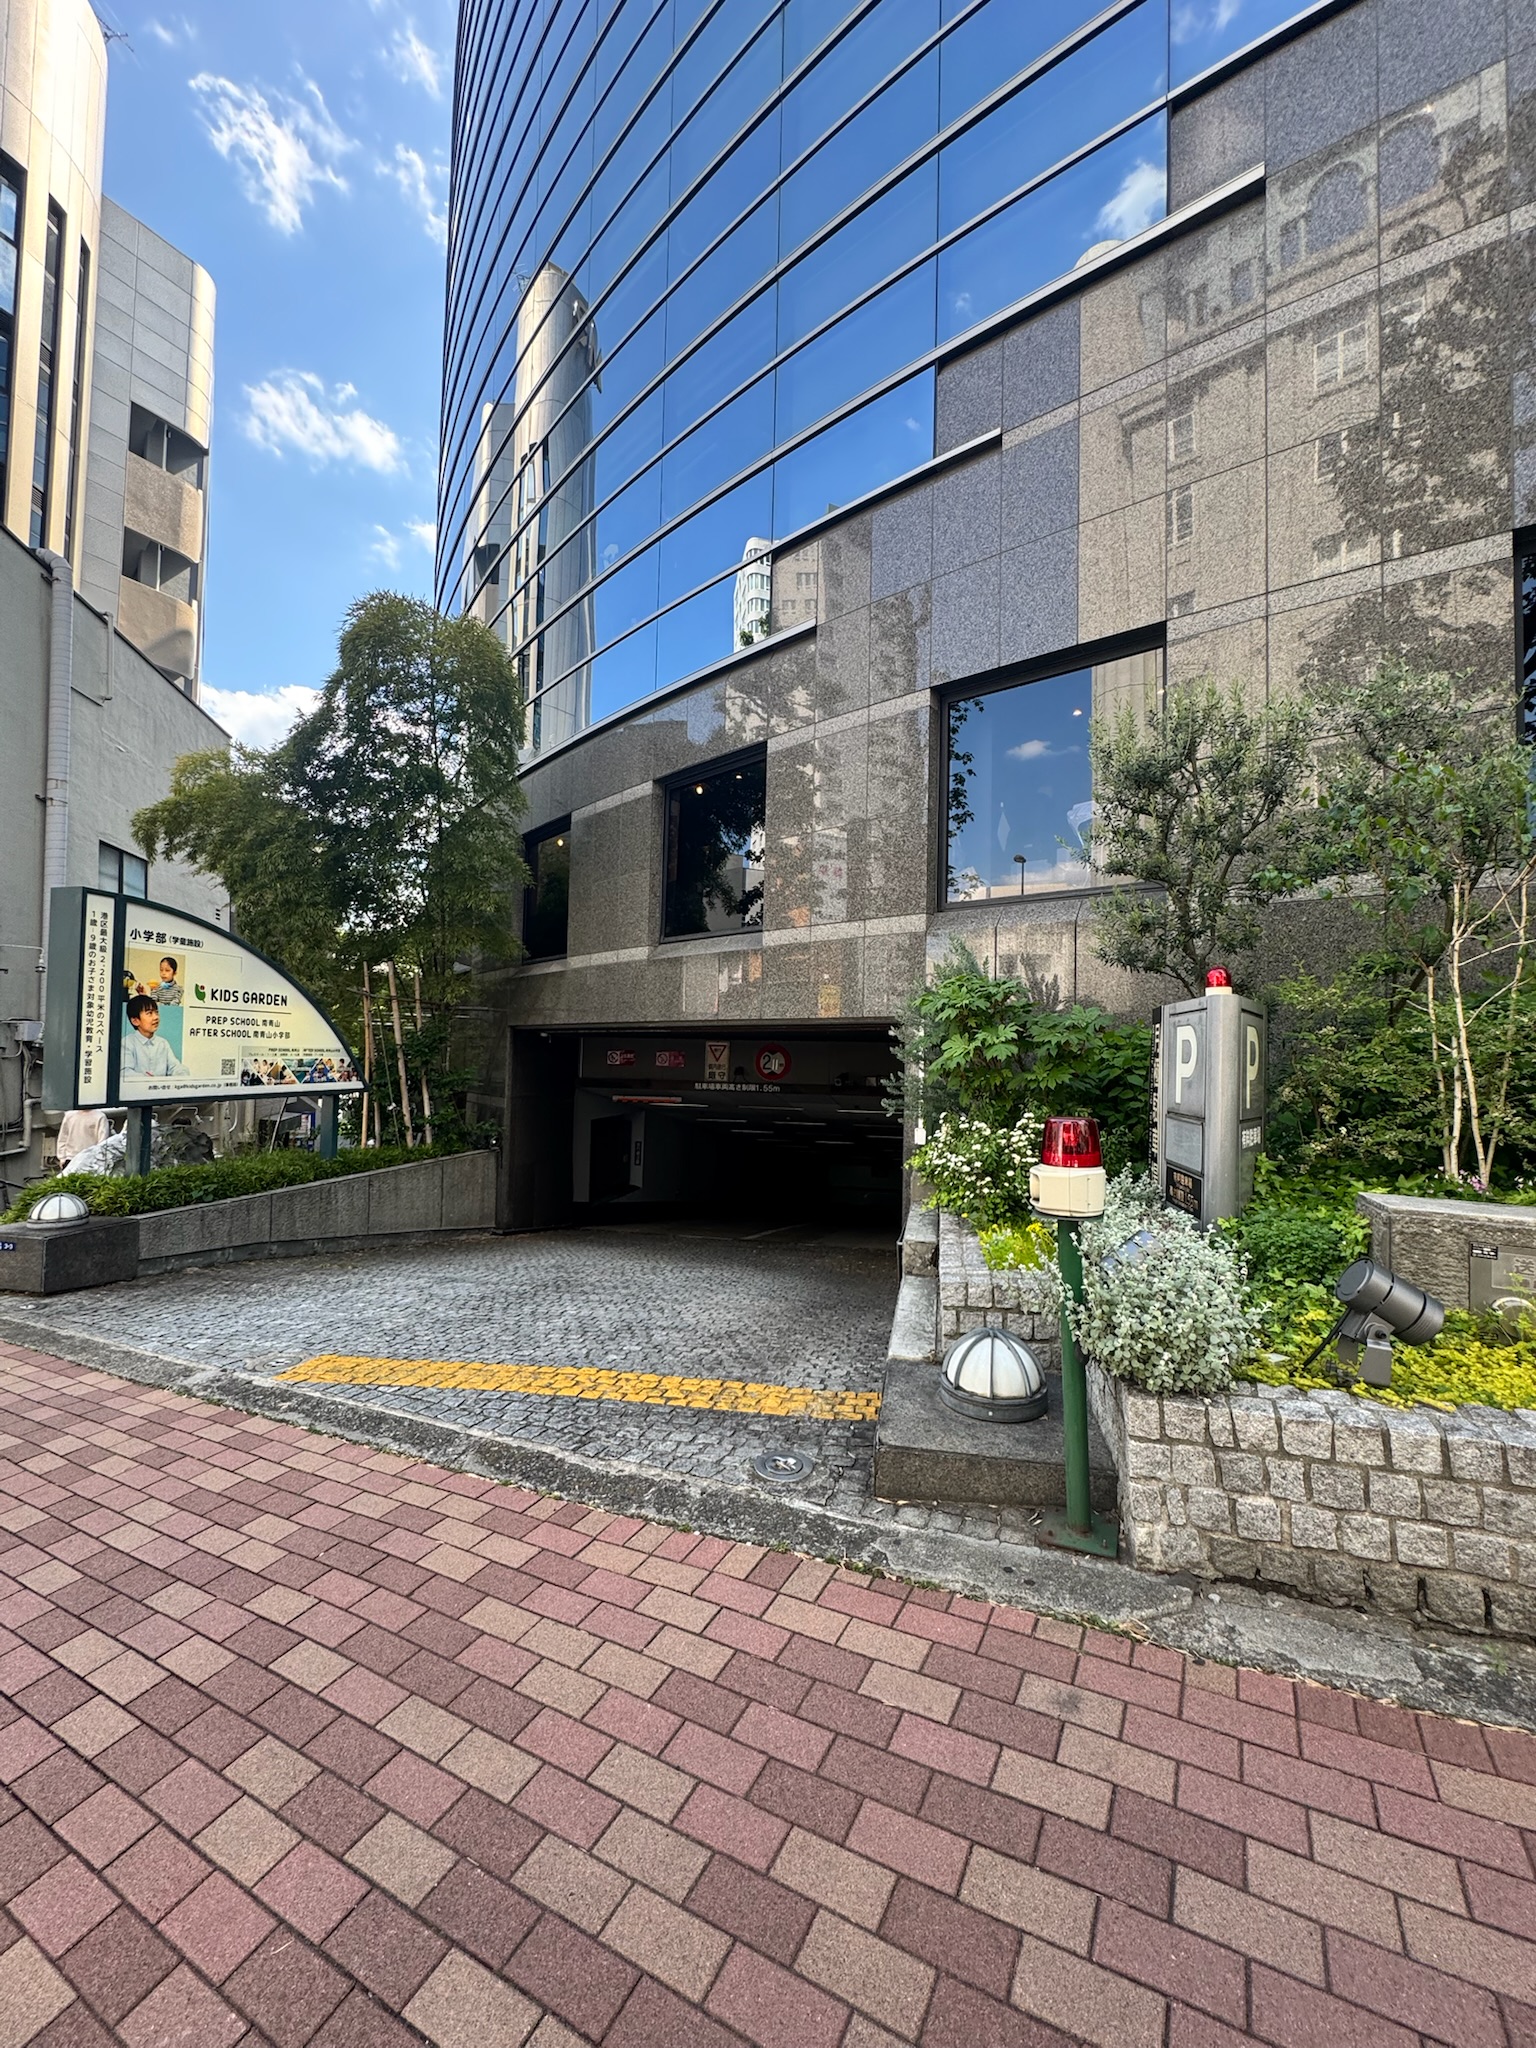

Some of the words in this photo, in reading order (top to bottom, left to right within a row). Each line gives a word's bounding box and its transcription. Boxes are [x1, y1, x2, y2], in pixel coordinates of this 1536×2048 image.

[130, 928, 167, 944] 小学部
[210, 988, 239, 1003] KIDS
[242, 990, 288, 1007] GARDEN
[205, 1015, 228, 1025] PREP
[230, 1016, 260, 1026] SCHOOL
[189, 1027, 218, 1037] AFTER
[220, 1028, 251, 1038] SCHOOL
[1175, 1024, 1198, 1104] P
[1246, 1025, 1260, 1109] P
